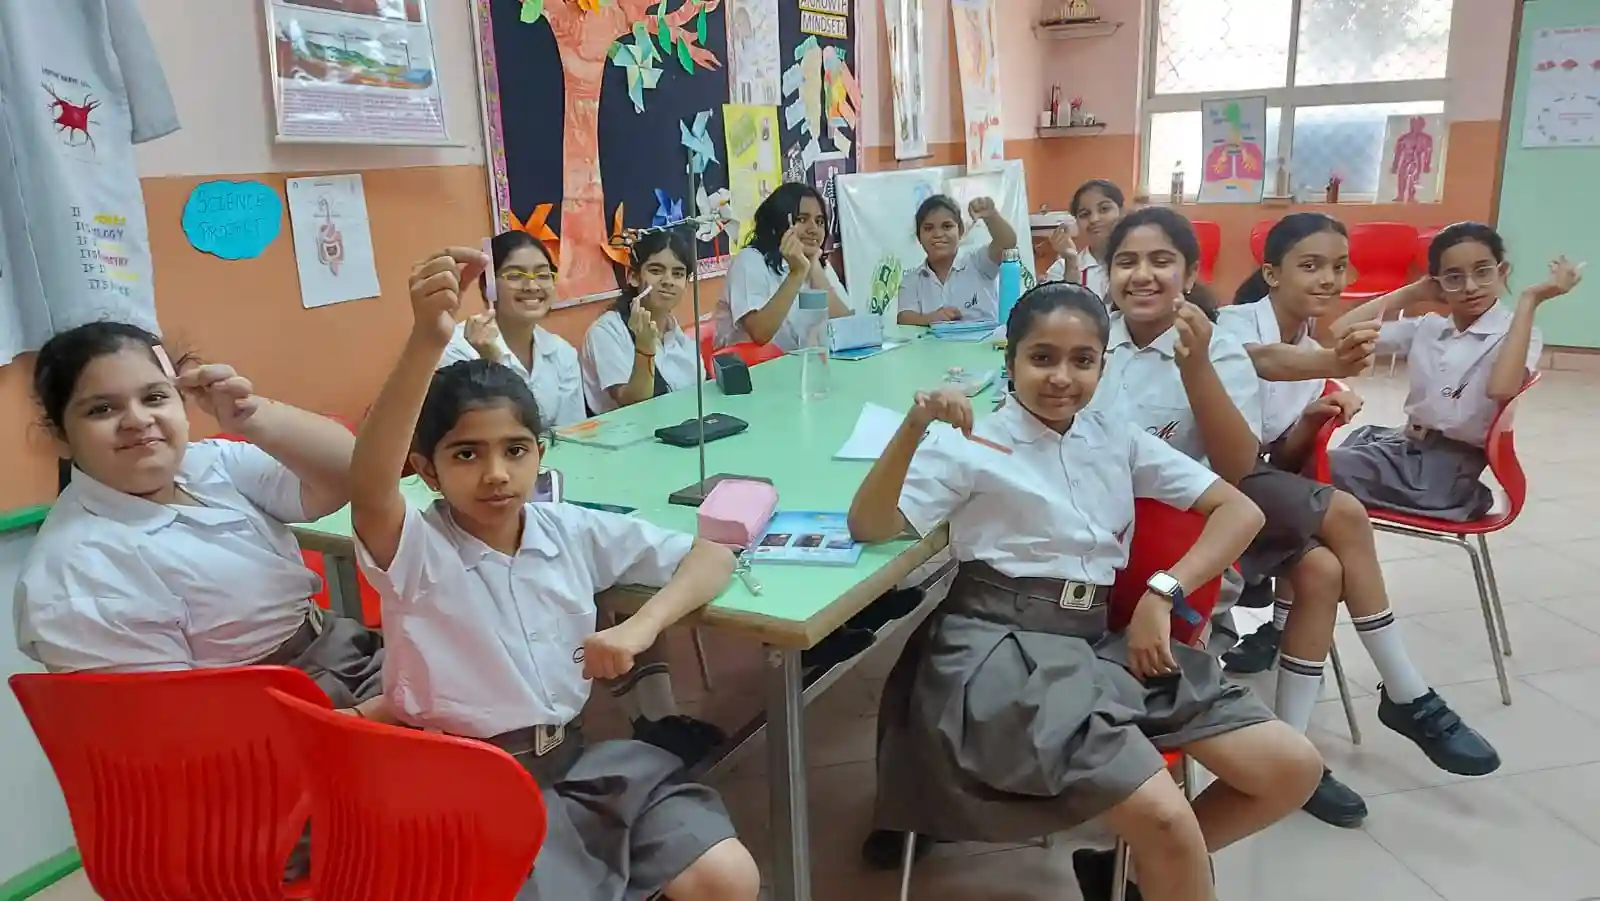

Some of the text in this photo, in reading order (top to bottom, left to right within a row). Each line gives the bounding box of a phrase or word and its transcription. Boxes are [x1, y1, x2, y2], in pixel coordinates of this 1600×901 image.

[803, 14, 846, 34] MINDSET?
[198, 189, 267, 214] SCIENCE
[198, 217, 267, 242] PROJECT
